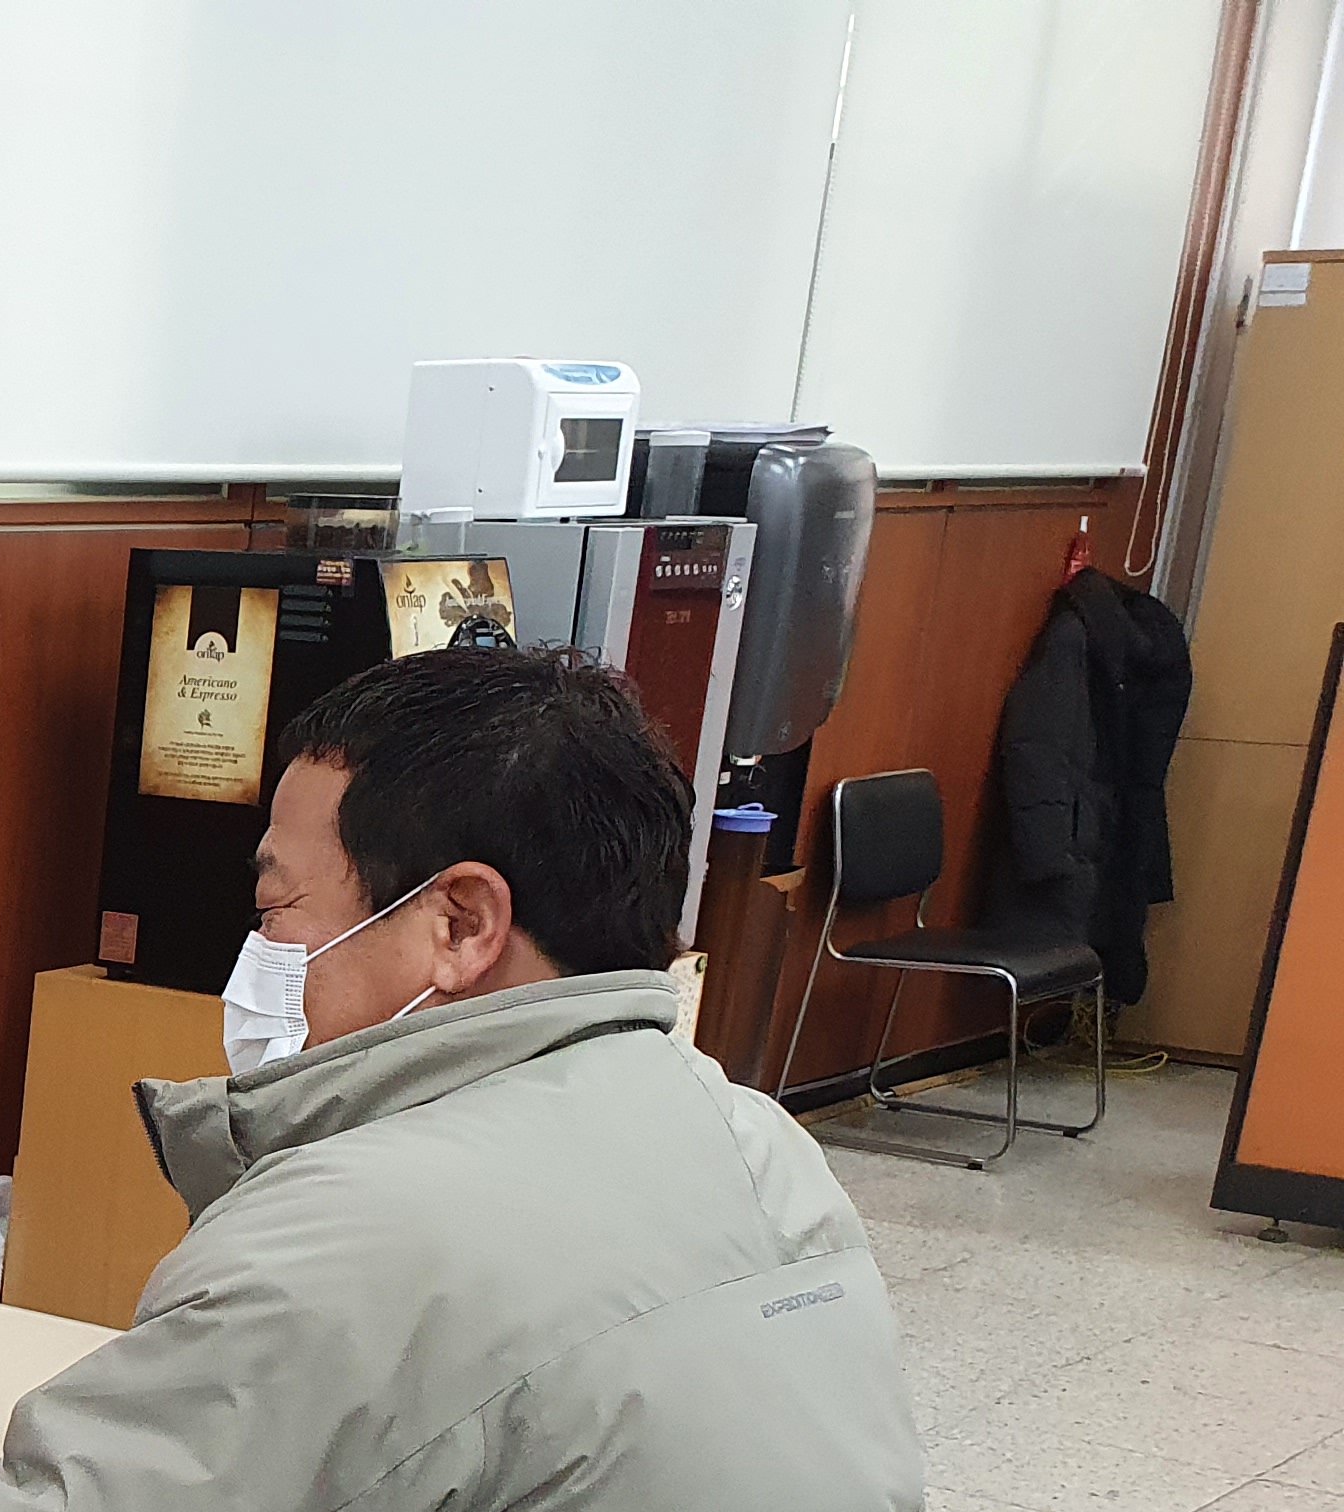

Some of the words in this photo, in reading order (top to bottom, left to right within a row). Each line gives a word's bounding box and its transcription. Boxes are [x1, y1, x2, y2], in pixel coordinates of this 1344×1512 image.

[178, 674, 238, 690] Americano
[177, 686, 187, 699] &
[190, 687, 238, 702] Espresso
